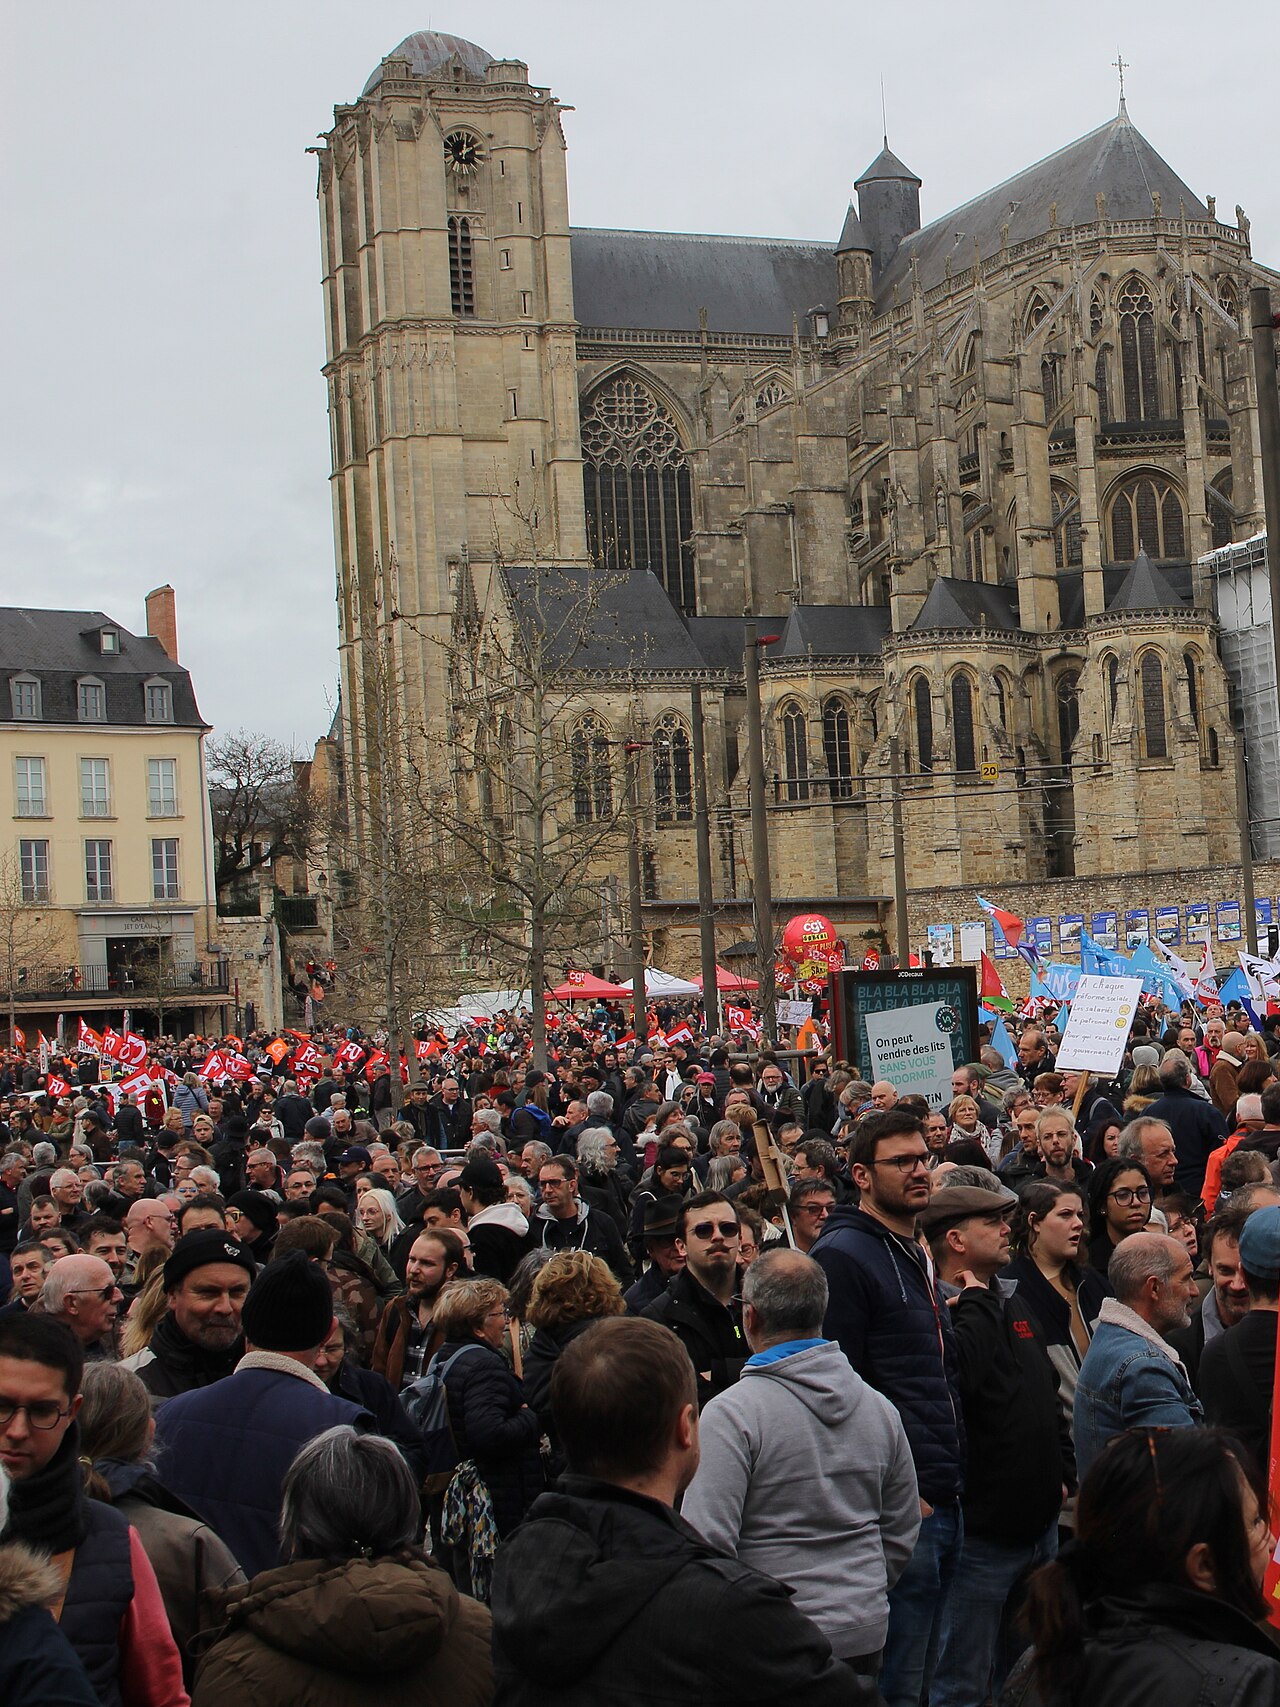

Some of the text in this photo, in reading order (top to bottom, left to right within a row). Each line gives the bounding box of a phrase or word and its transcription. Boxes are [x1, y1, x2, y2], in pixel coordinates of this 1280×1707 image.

[803, 919, 824, 932] cgt
[858, 983, 961, 998] BLA BLA BLA BLA
[1093, 978, 1124, 994] chaque
[1076, 992, 1105, 1001] réforme
[858, 1000, 883, 1012] BLA
[876, 1034, 913, 1048] On peut
[1082, 1033, 1091, 1042] qui
[878, 1041, 945, 1061] vendre des lits
[880, 1055, 936, 1074] SANS VOUS
[50, 1078, 65, 1094] FO
